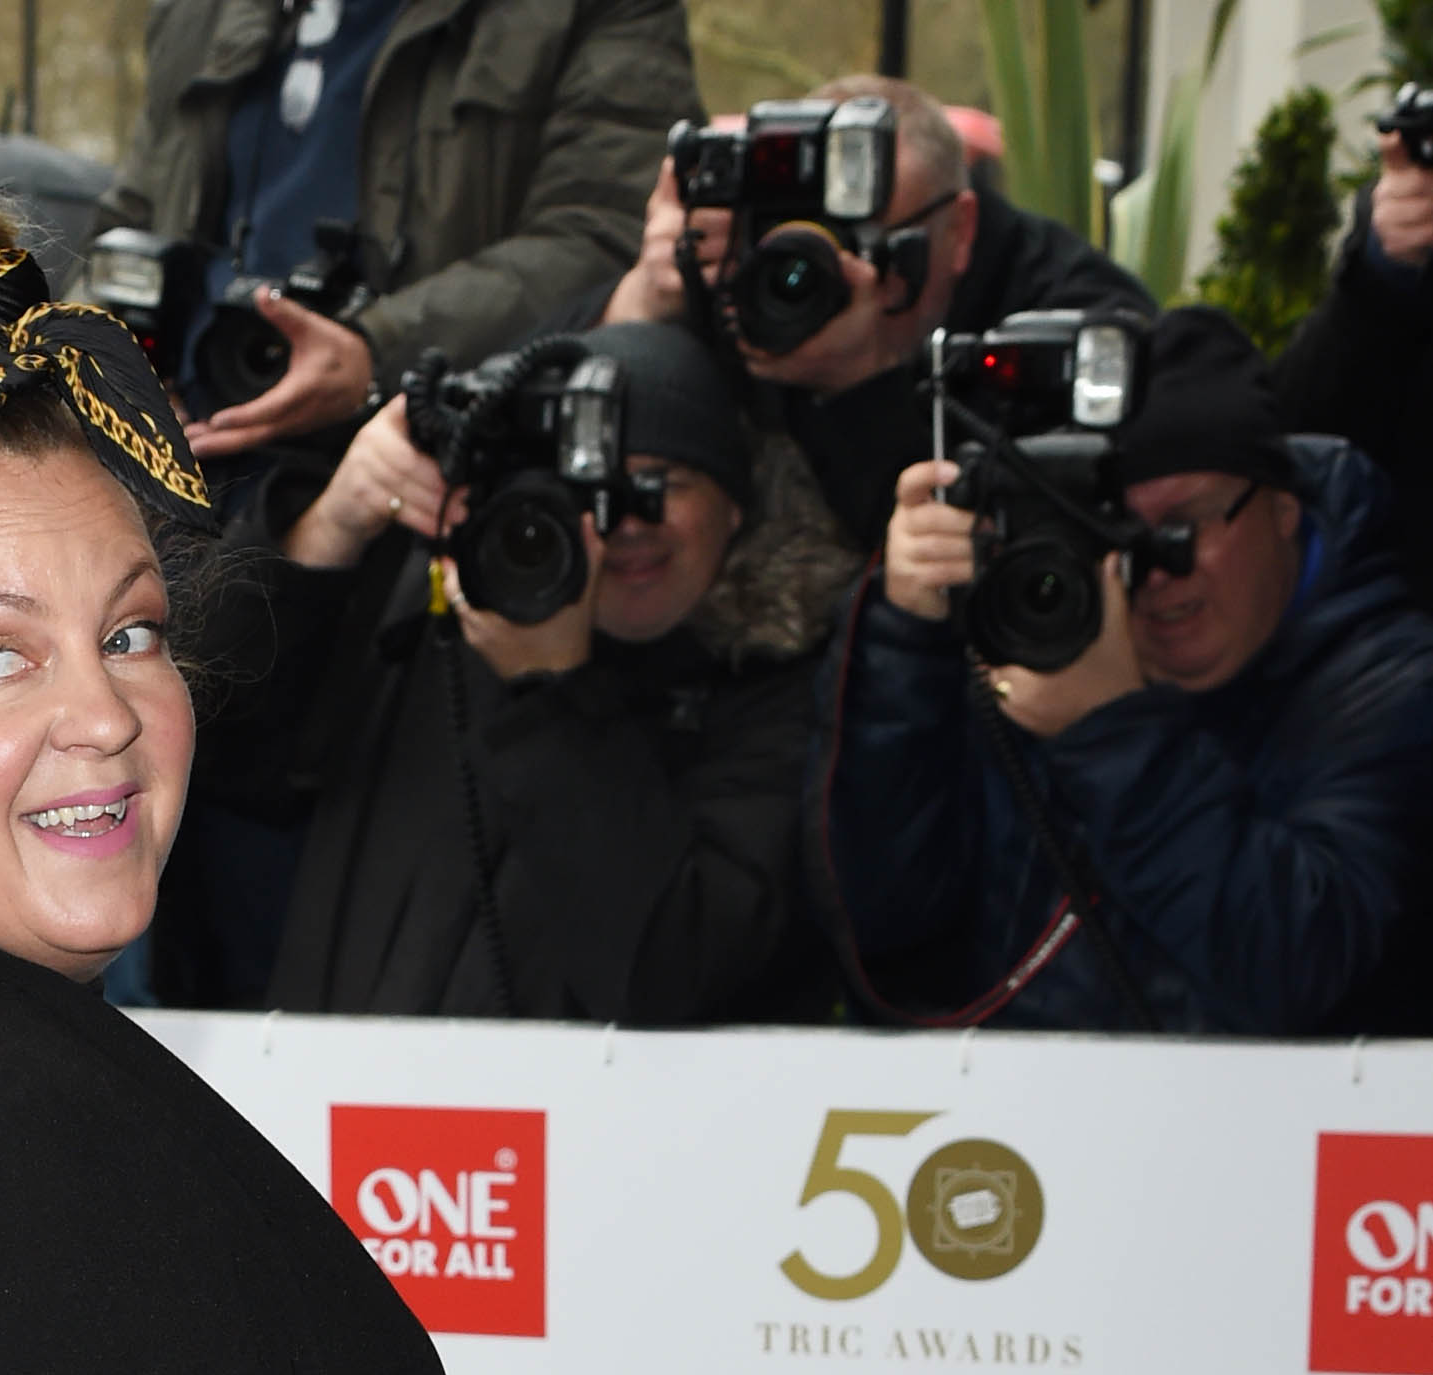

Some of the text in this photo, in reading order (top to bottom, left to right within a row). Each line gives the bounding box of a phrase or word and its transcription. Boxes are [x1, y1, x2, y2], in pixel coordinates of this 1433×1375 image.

[357, 1166, 517, 1240] ONE
[444, 1240, 515, 1281] ALL
[1344, 1273, 1433, 1317] FOR
[754, 1321, 1085, 1367] TRIC AWARDS
